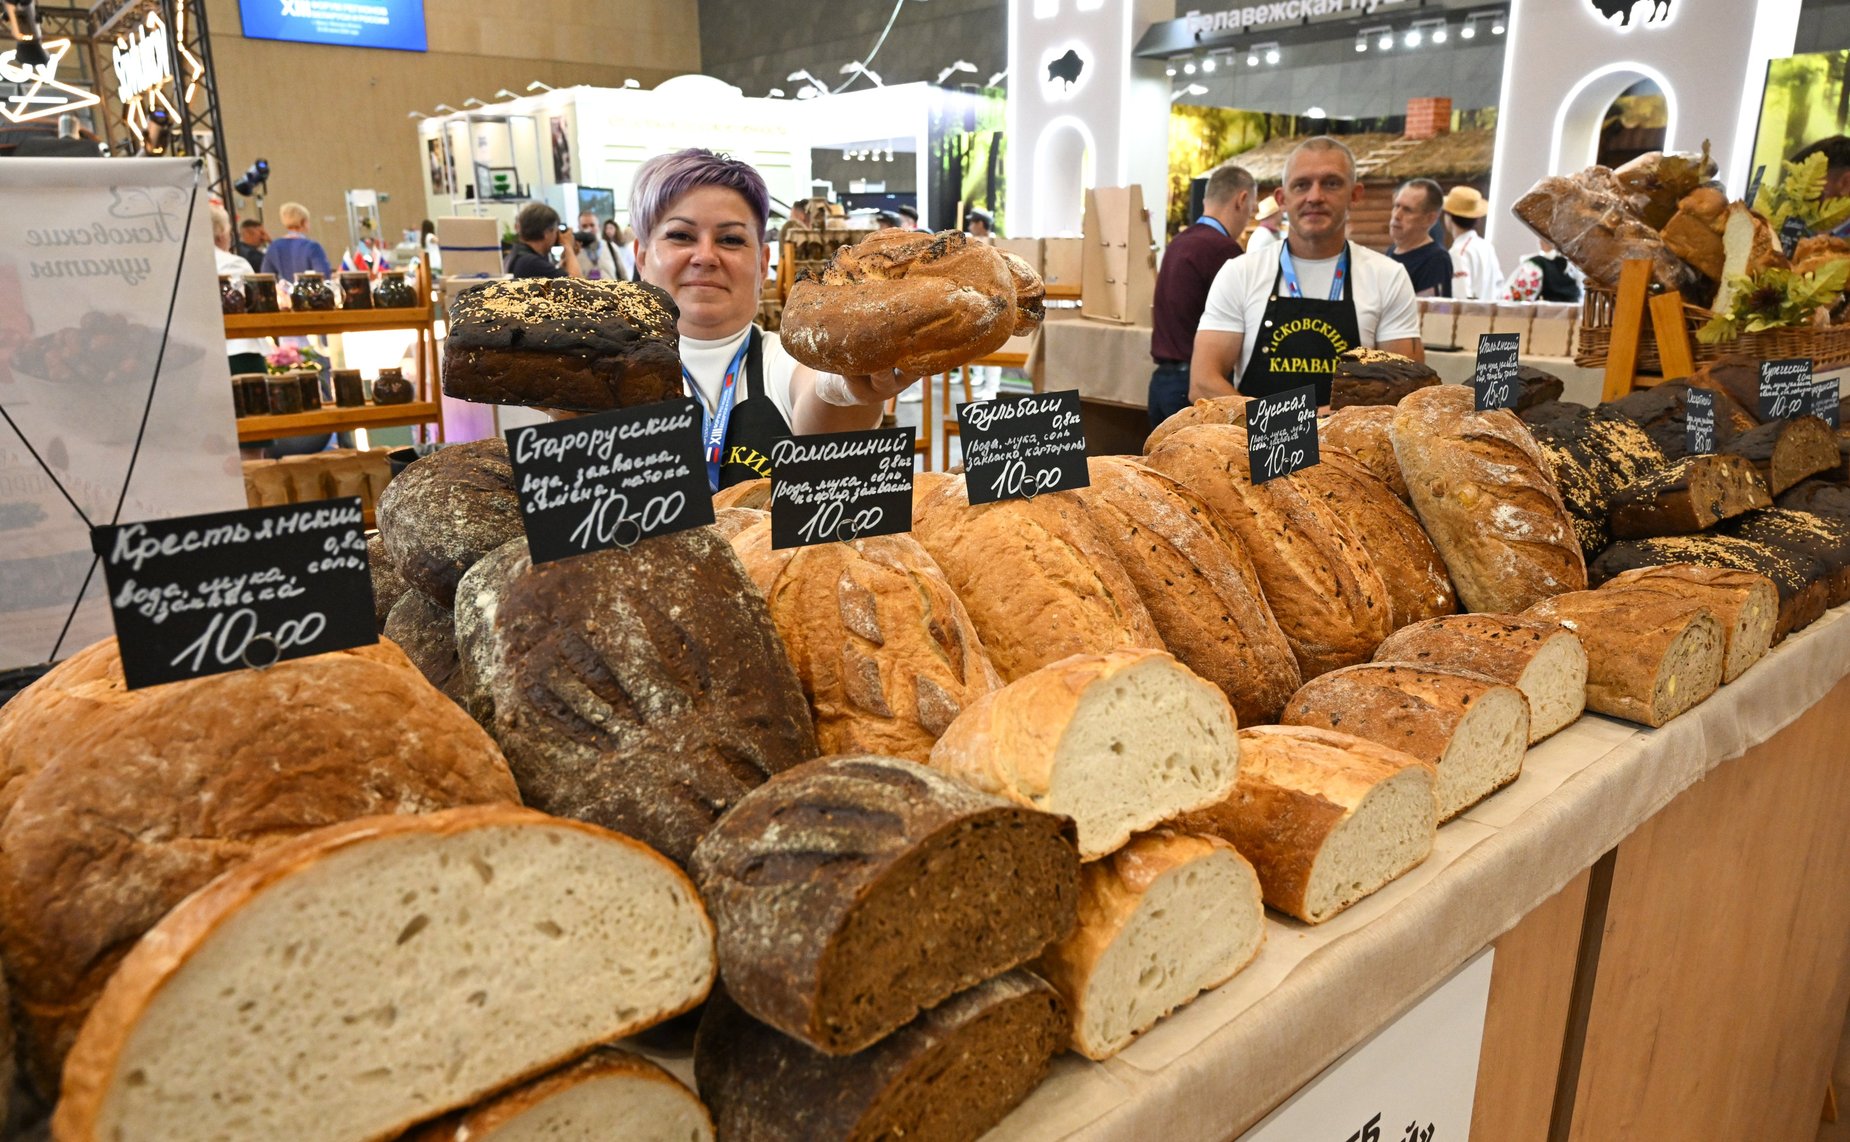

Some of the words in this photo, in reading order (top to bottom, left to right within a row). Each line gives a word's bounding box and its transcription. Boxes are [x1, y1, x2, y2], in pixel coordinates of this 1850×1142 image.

[516, 404, 694, 463] Старорусский
[962, 397, 1062, 431] Бульбаш
[1249, 394, 1306, 433] Русская
[771, 432, 907, 468] Домашний
[110, 497, 363, 570] Крестьянский
[569, 490, 686, 549] 10-00
[170, 608, 327, 672] 10-00
